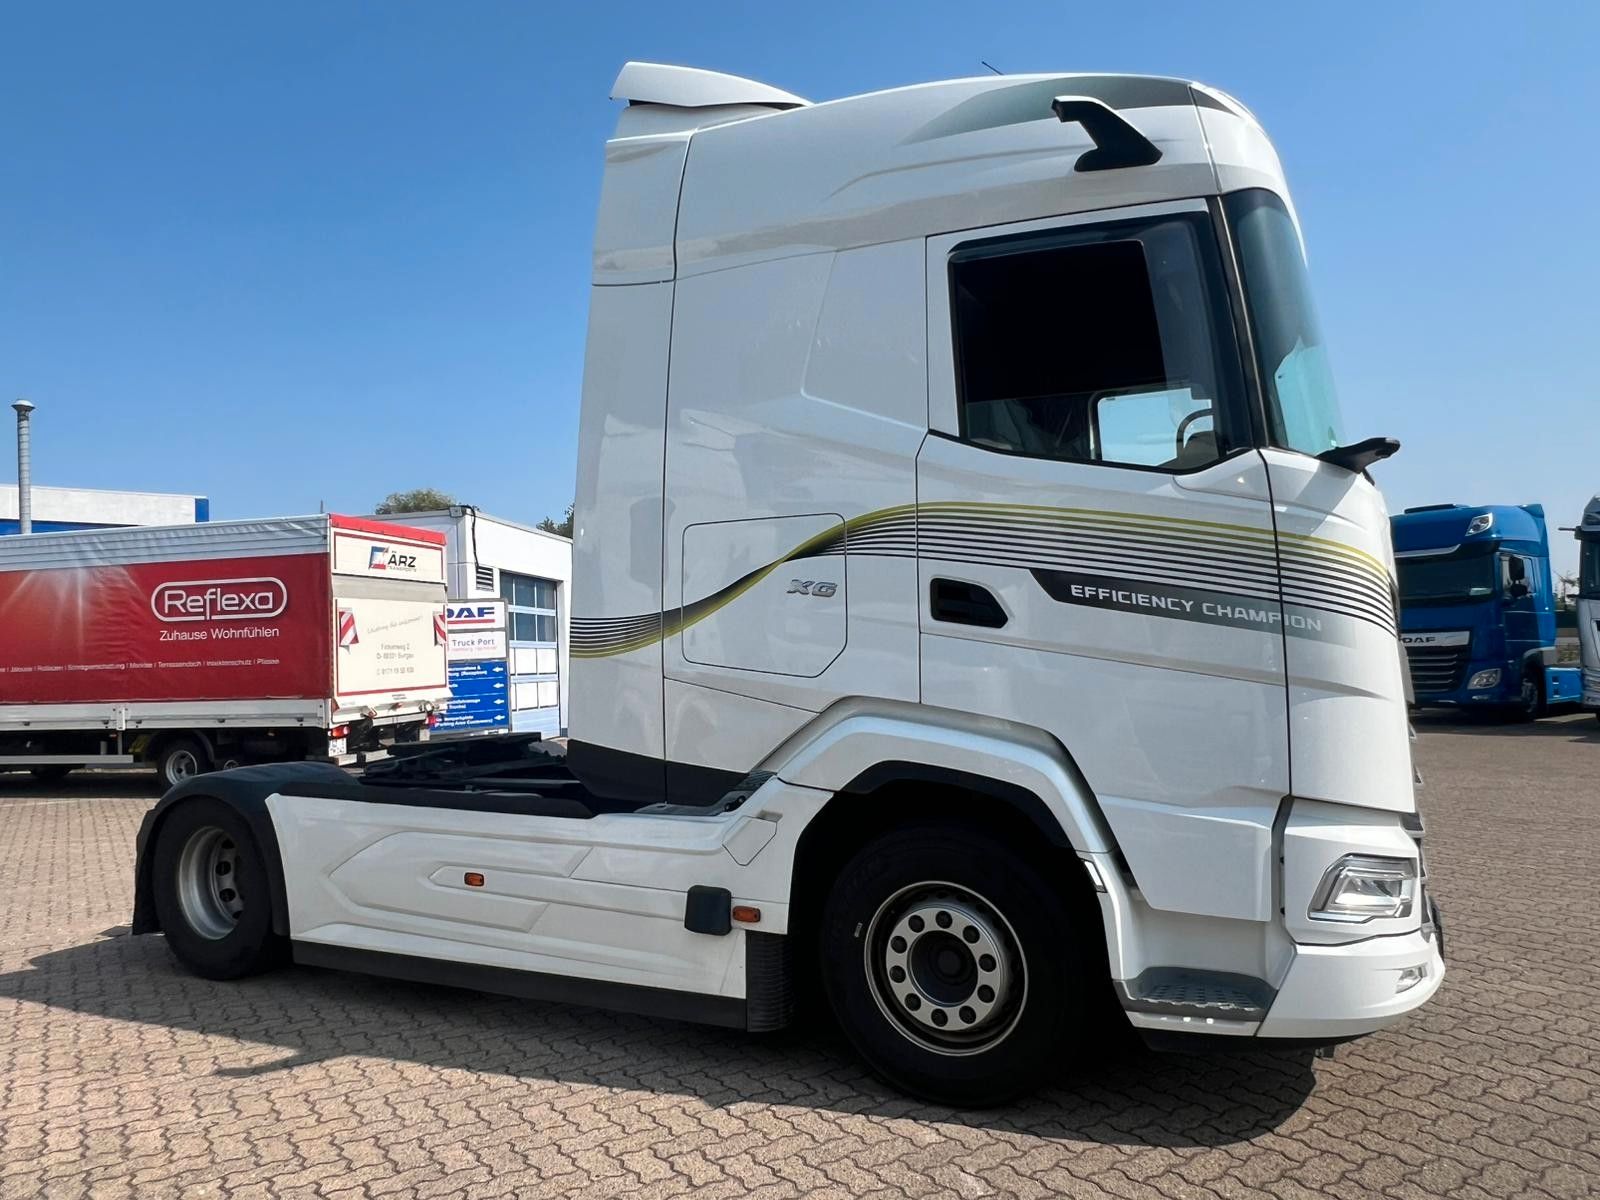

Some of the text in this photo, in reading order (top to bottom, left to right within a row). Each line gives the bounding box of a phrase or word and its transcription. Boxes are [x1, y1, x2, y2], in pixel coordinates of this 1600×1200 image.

[388, 551, 416, 568] ÄRZ
[786, 579, 838, 597] XG
[164, 587, 273, 620] Reflexa
[1070, 584, 1323, 632] EFFICIENCY CHAMPION
[160, 626, 280, 641] Zuhause Wohnfühlen
[451, 638, 495, 647] Truck Port
